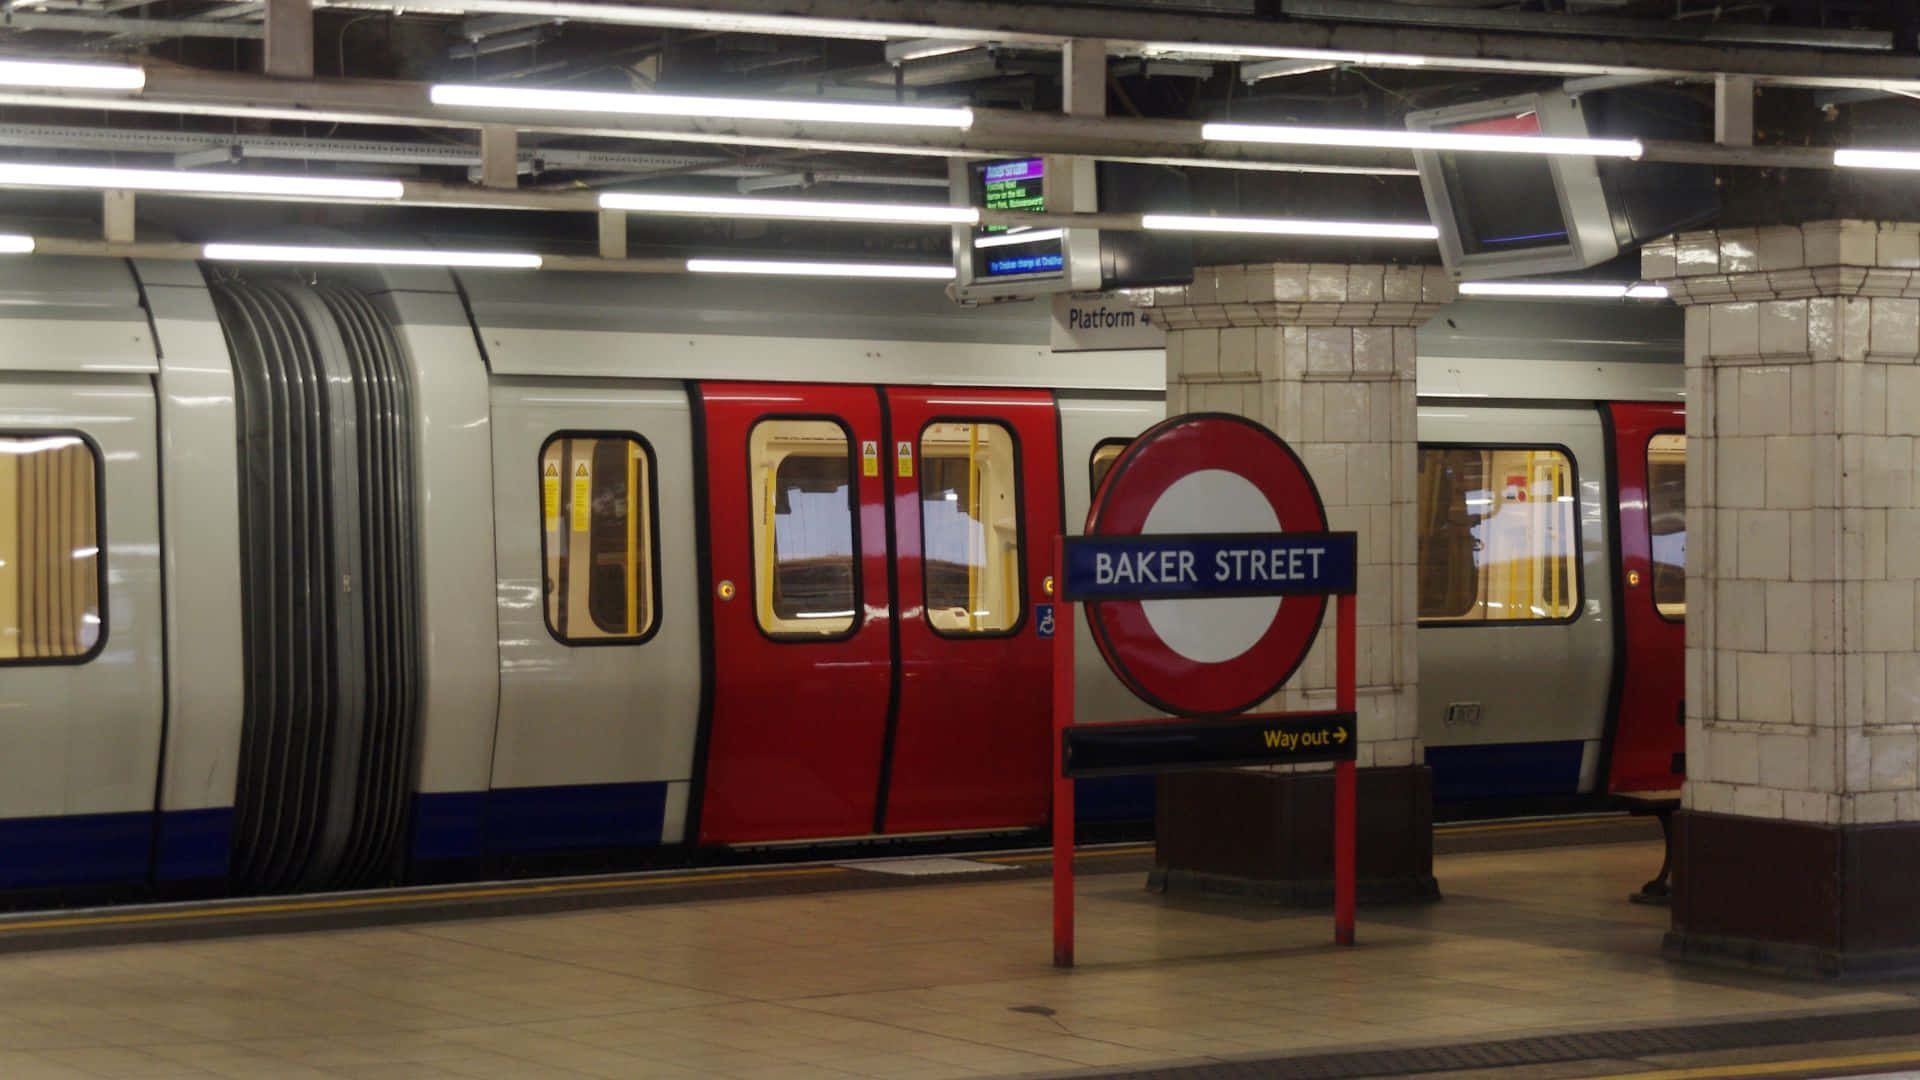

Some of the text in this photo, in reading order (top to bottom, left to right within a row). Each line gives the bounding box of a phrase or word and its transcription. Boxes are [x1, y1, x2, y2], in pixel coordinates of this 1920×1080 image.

[1069, 306, 1151, 329] Platform 4
[1096, 547, 1325, 584] BAKER STREET
[1263, 728, 1329, 751] Way out
